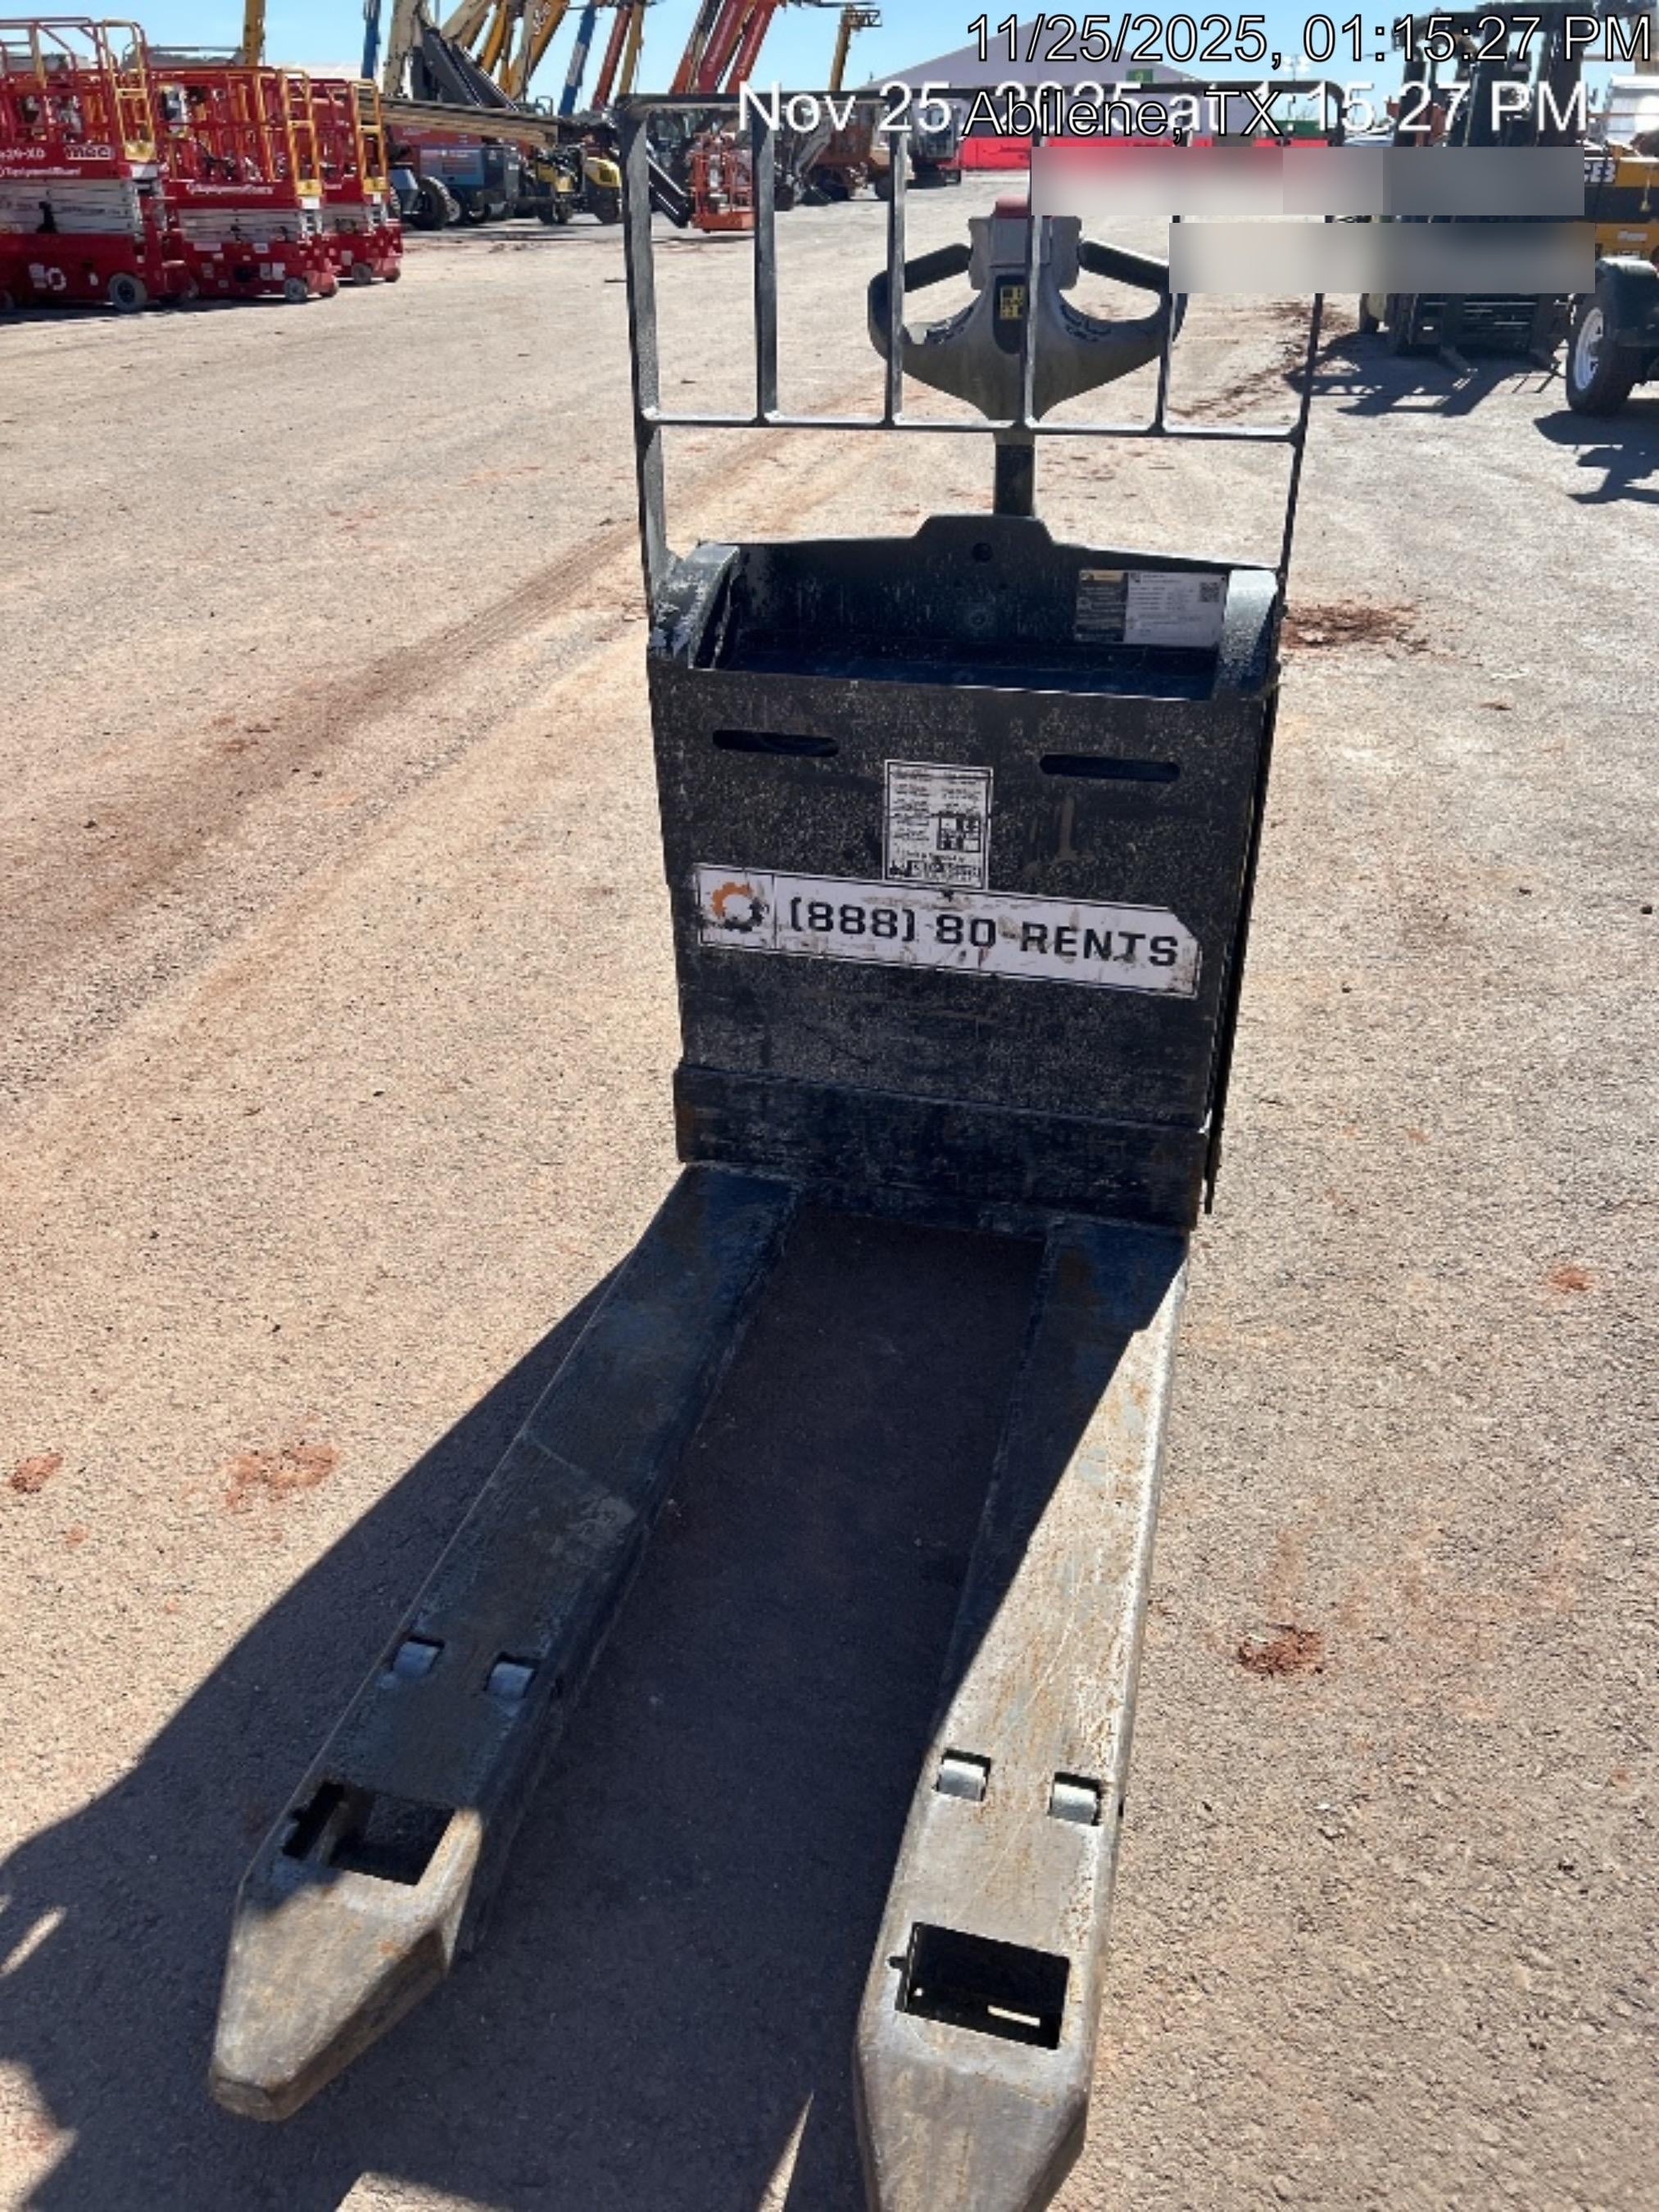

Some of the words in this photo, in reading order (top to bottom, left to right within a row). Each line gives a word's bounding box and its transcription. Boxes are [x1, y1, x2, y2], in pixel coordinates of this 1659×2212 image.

[790, 896, 915, 942] (888)
[936, 913, 996, 948] 80
[1020, 922, 1179, 967] RENTS
